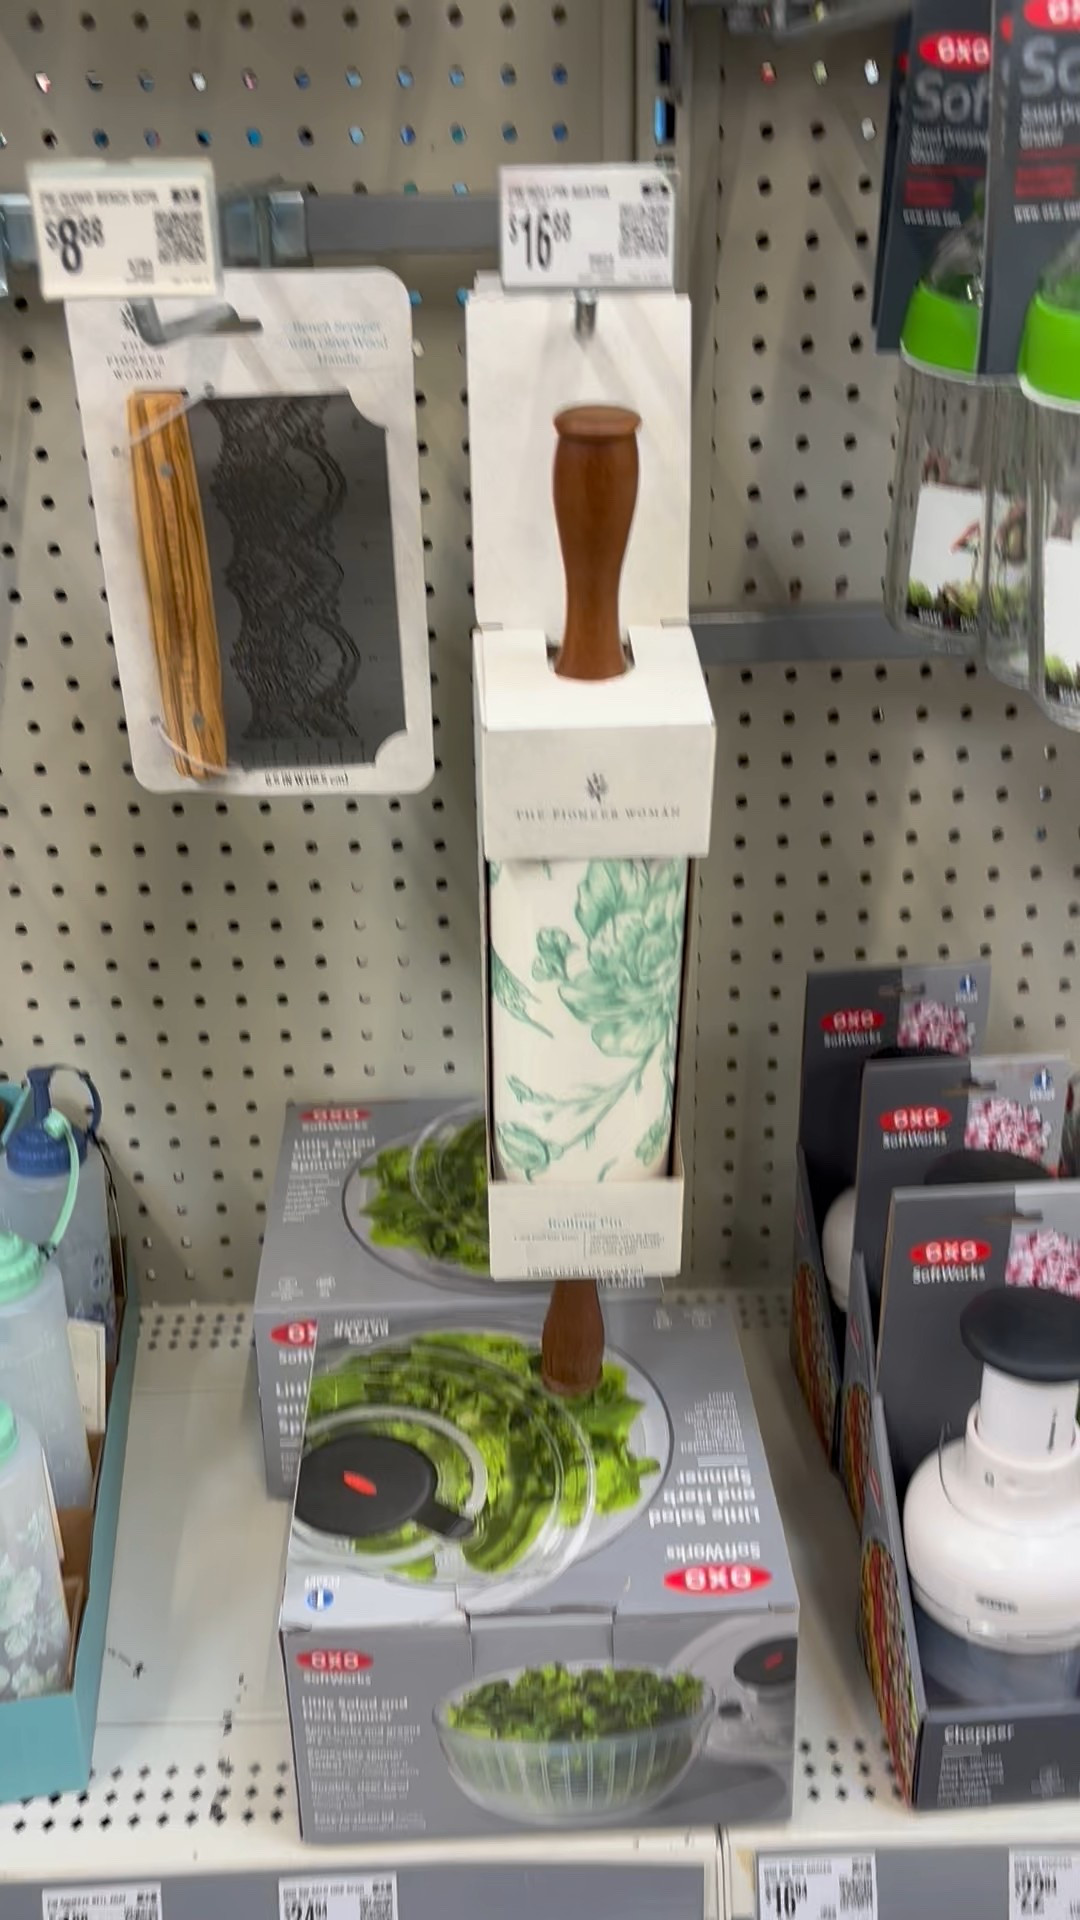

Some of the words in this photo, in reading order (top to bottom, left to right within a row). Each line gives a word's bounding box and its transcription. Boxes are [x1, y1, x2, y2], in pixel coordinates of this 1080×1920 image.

[938, 35, 990, 65] OXO
[106, 354, 167, 368] PIONEER
[112, 368, 163, 381] WOMAN
[516, 808, 545, 822] THE
[552, 807, 619, 821] PIONEER
[625, 805, 681, 819] WOMAN
[833, 1010, 875, 1030] OXO
[893, 1107, 940, 1129] OXO
[882, 1131, 947, 1149] SoftWorks
[548, 1216, 596, 1231] Rolling
[600, 1216, 624, 1229] Pin
[925, 1240, 977, 1263] OXO
[912, 1265, 986, 1284] SoftWorks
[677, 1465, 752, 1486] Spinner
[649, 1507, 706, 1529] Salad
[711, 1506, 760, 1525] Little
[665, 1541, 761, 1563] SoftWorks
[685, 1564, 752, 1592] OXO
[311, 1651, 359, 1670] OXO
[944, 1723, 1015, 1746] Chopper
